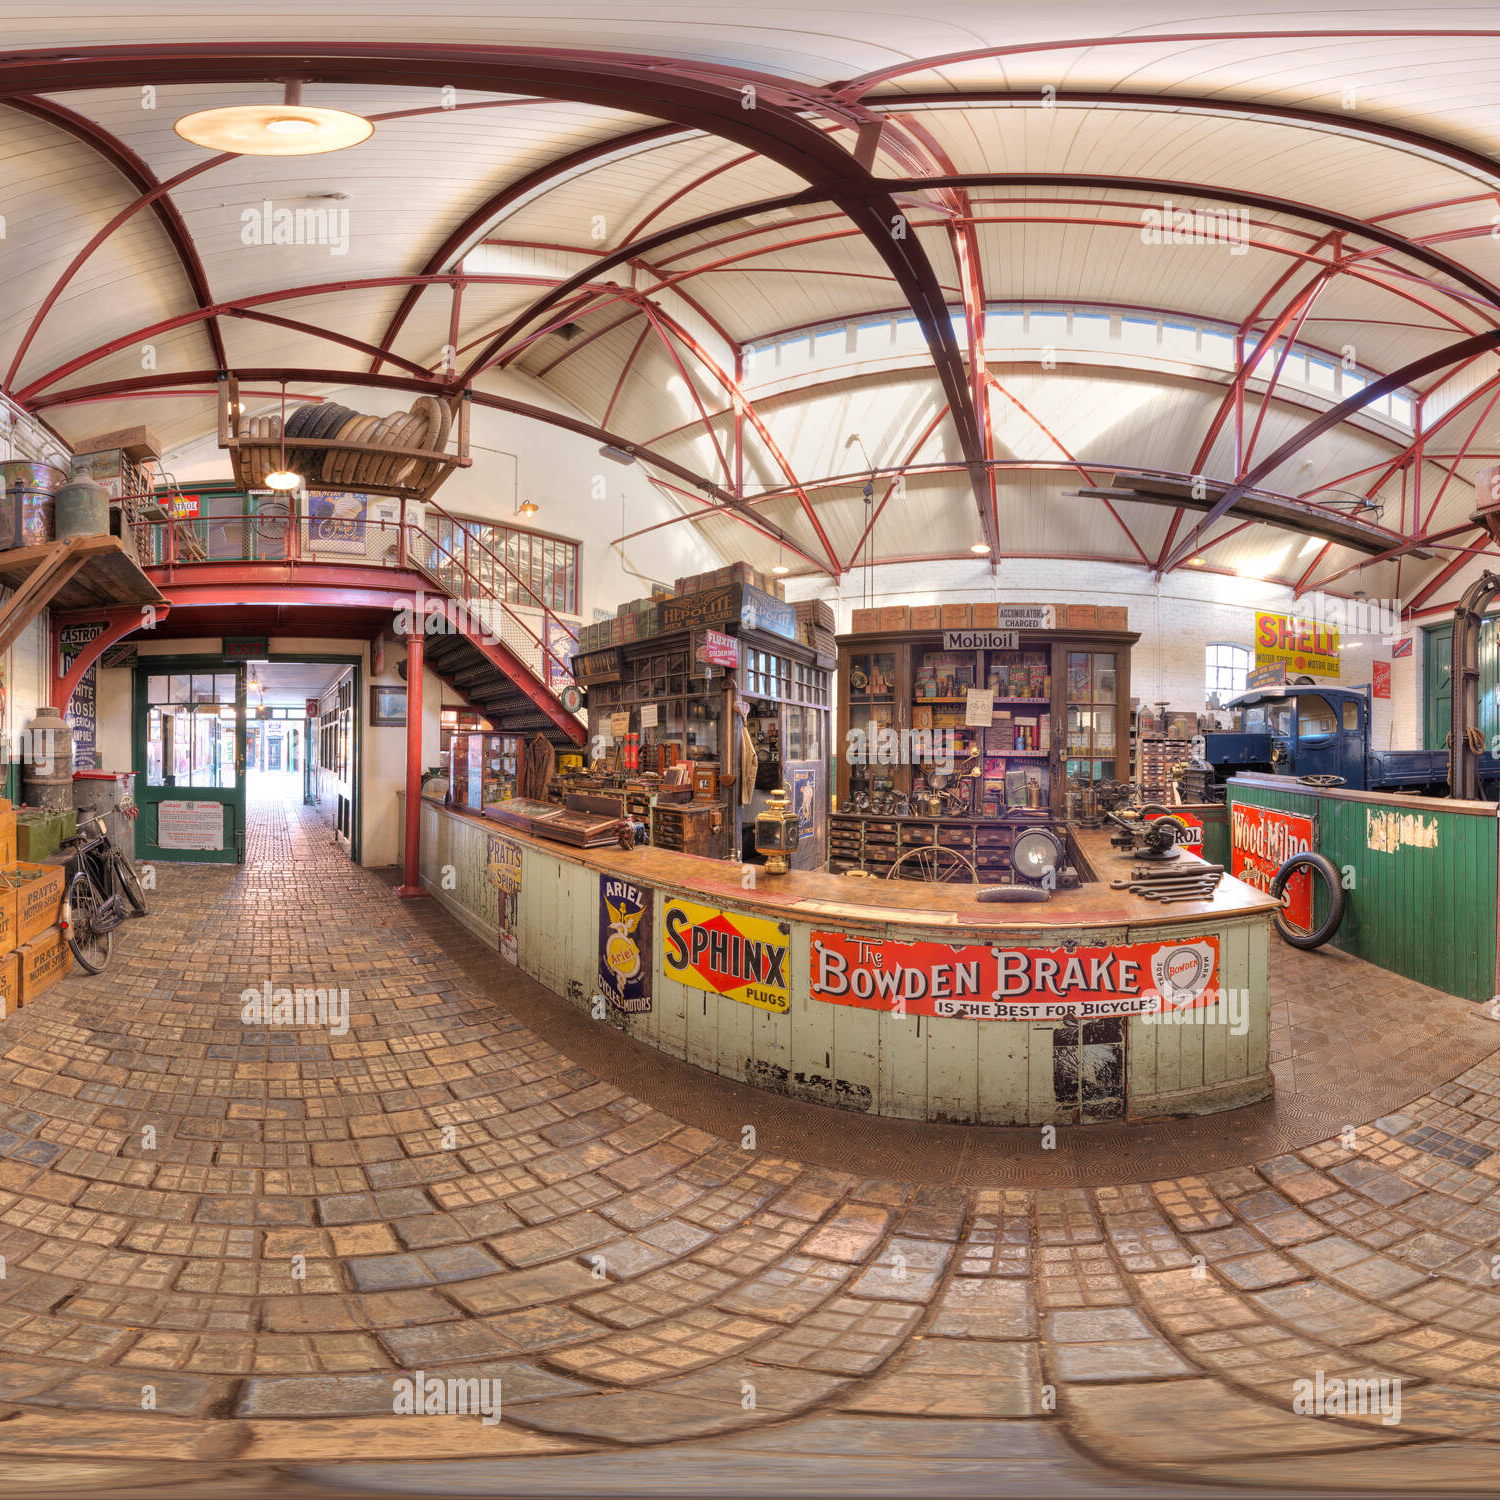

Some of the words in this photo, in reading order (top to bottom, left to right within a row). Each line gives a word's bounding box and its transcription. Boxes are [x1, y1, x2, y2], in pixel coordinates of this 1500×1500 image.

[664, 592, 733, 624] HEPOLITE
[1000, 608, 1046, 620] ACCUMULATORS
[1005, 619, 1039, 628] CHARGED
[708, 632, 738, 650] FLUXITE
[950, 633, 1013, 648] Mobiloil
[1258, 616, 1340, 657] SHELL
[227, 643, 264, 656] EXIT
[1257, 653, 1275, 665] MOTOR
[1307, 659, 1326, 670] MOTOR
[1327, 661, 1339, 673] OILS
[68, 698, 95, 718] ROSE
[497, 869, 521, 893] SPIRIT
[606, 881, 645, 909] ARIEL
[23, 901, 43, 921] MOTOR
[611, 947, 636, 966] Ariel
[664, 907, 788, 990] SPHINX
[845, 938, 884, 968] The
[813, 939, 982, 1000] BOWDEN
[990, 948, 1142, 1001] BRAKE
[1155, 961, 1165, 986] TRADE
[1168, 958, 1199, 977] BOWDEN
[1202, 955, 1210, 979] MARK
[599, 974, 622, 1009] CYCLES
[623, 996, 651, 1012] MOTORS
[746, 987, 787, 1008] PLUGS
[938, 1002, 955, 1013] IS
[960, 1003, 991, 1016] THE
[994, 1003, 1040, 1017] BEST
[1045, 1004, 1076, 1017] FOR
[1081, 999, 1159, 1016] BICYCLES
